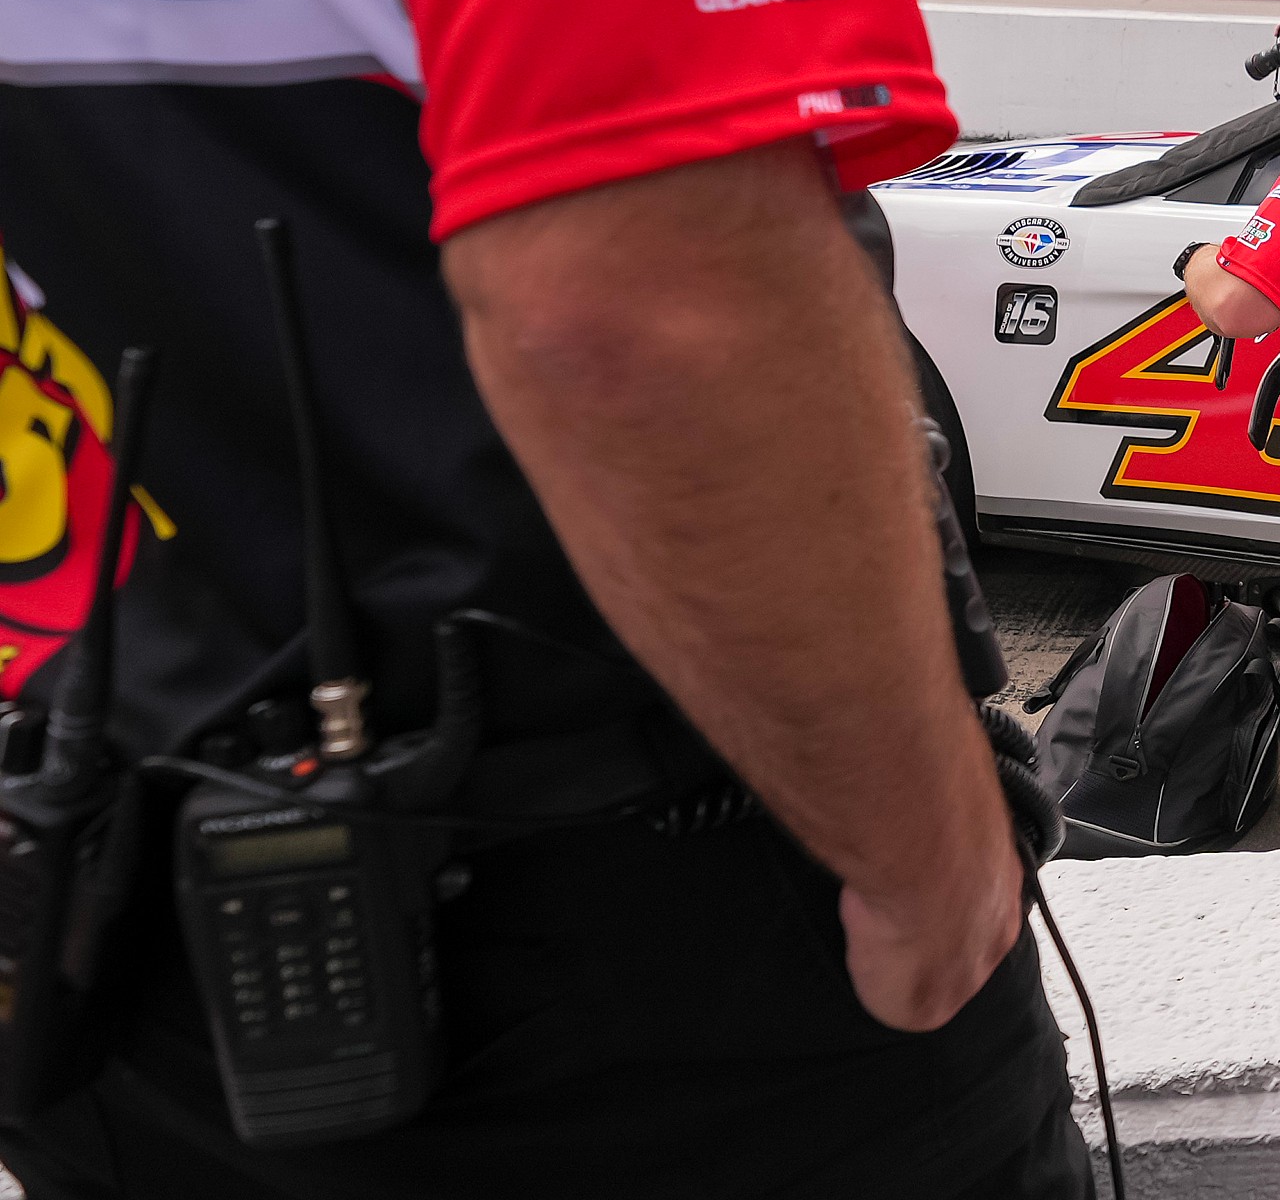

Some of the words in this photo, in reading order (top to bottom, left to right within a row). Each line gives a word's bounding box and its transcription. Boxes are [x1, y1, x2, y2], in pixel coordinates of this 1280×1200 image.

[1010, 218, 1042, 232] NASCAR
[1044, 218, 1062, 236] 75TH
[1004, 246, 1060, 268] ANNIVERSARY
[1004, 292, 1056, 336] 16
